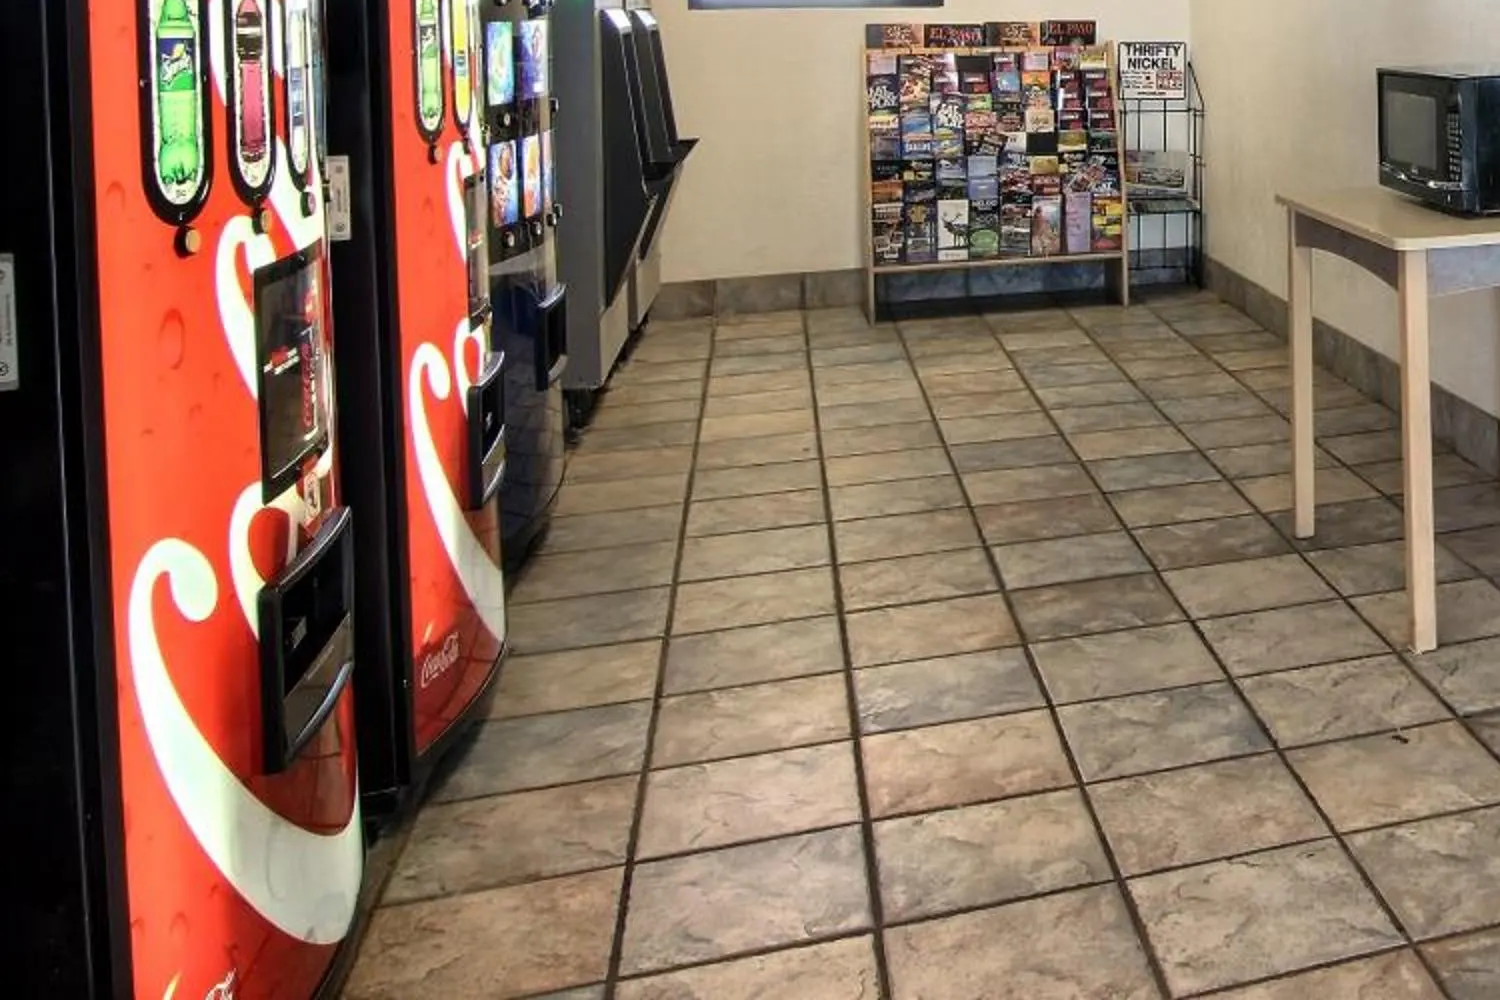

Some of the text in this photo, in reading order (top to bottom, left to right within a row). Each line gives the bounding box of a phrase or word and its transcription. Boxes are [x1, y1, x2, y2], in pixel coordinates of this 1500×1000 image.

[1049, 23, 1093, 34] EL PASO
[1124, 43, 1181, 57] THRIFTY
[1128, 58, 1176, 70] NICKEL
